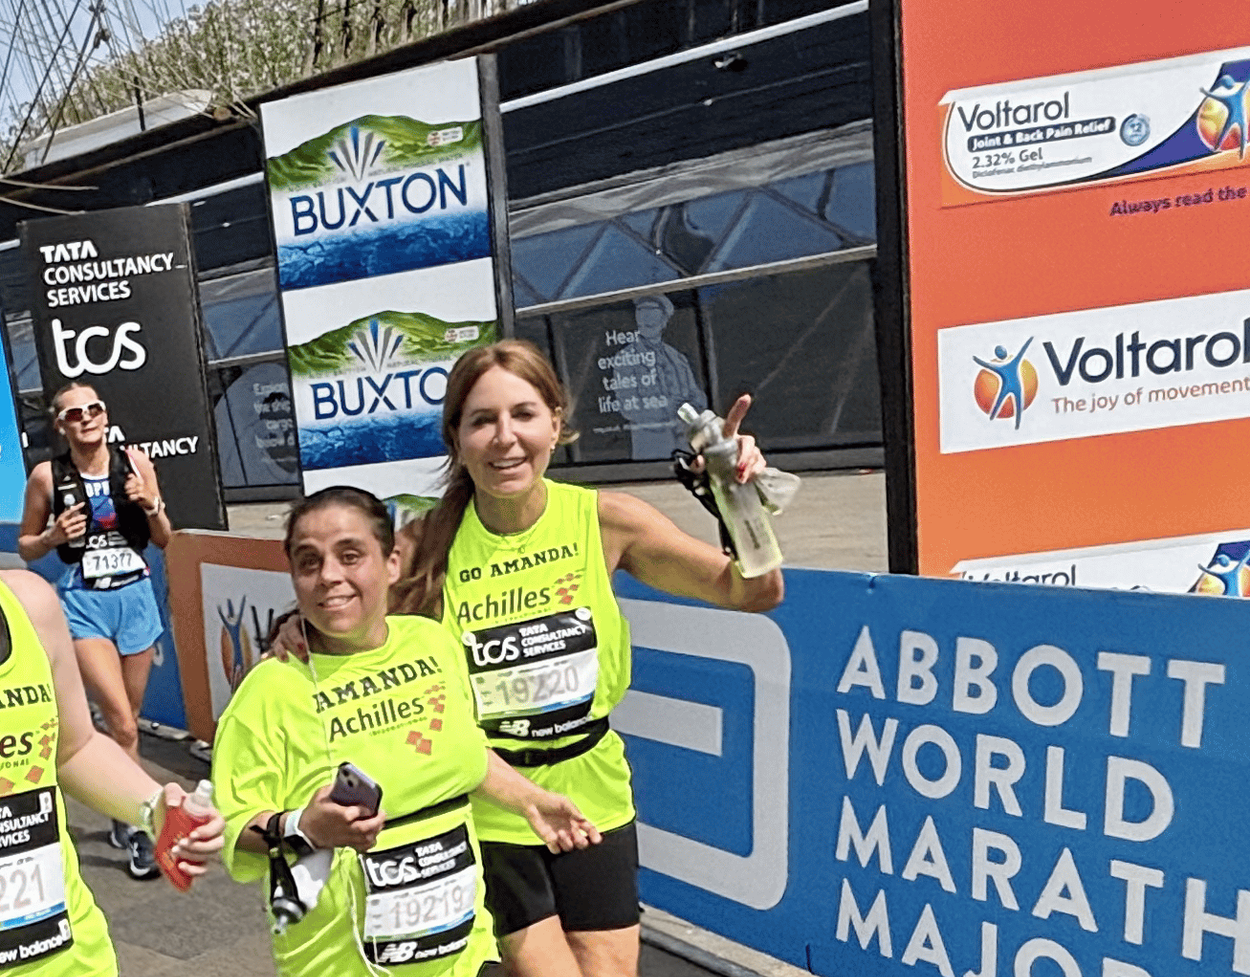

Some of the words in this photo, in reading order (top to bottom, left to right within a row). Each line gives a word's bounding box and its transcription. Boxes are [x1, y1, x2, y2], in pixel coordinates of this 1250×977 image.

[957, 91, 1070, 132] Voltarol
[972, 135, 1002, 151] Joint
[1002, 132, 1014, 144] &
[1015, 128, 1045, 144] Back
[1046, 125, 1073, 140] Pain
[1075, 118, 1113, 135] Relief
[972, 152, 1016, 169] 2.32%
[1019, 147, 1044, 162] Gel
[289, 164, 468, 236] BUXTON
[1110, 196, 1172, 217] Always
[1175, 188, 1214, 208] read
[1217, 185, 1248, 202] the
[39, 240, 98, 263] TATA
[43, 252, 174, 286] CONSULTANCY
[47, 280, 132, 308] SERVICES
[51, 318, 146, 378] tcs
[605, 330, 641, 346] Hear
[1042, 316, 1250, 387] Voltarol
[597, 347, 656, 370] exciting
[310, 366, 450, 419] BUXTO
[602, 371, 638, 392] tales
[640, 367, 658, 387] of
[1051, 395, 1088, 414] The
[1088, 393, 1120, 414] joy
[1123, 387, 1144, 406] of
[1148, 376, 1250, 402] movement
[598, 395, 621, 414] life
[623, 395, 640, 411] at
[641, 394, 669, 410] sea
[459, 567, 482, 583] GO
[490, 542, 580, 577] AMANDA!
[457, 586, 550, 625] Achilles
[519, 623, 549, 637] TATA
[470, 637, 520, 666] tcs
[312, 656, 443, 714] AMANDA!
[836, 625, 1227, 748] ABBOTT
[329, 698, 424, 743] Achilles
[836, 708, 1175, 842] WORLD
[366, 856, 417, 887] tcs
[835, 795, 1250, 976] MARATH
[390, 885, 464, 929] 19219
